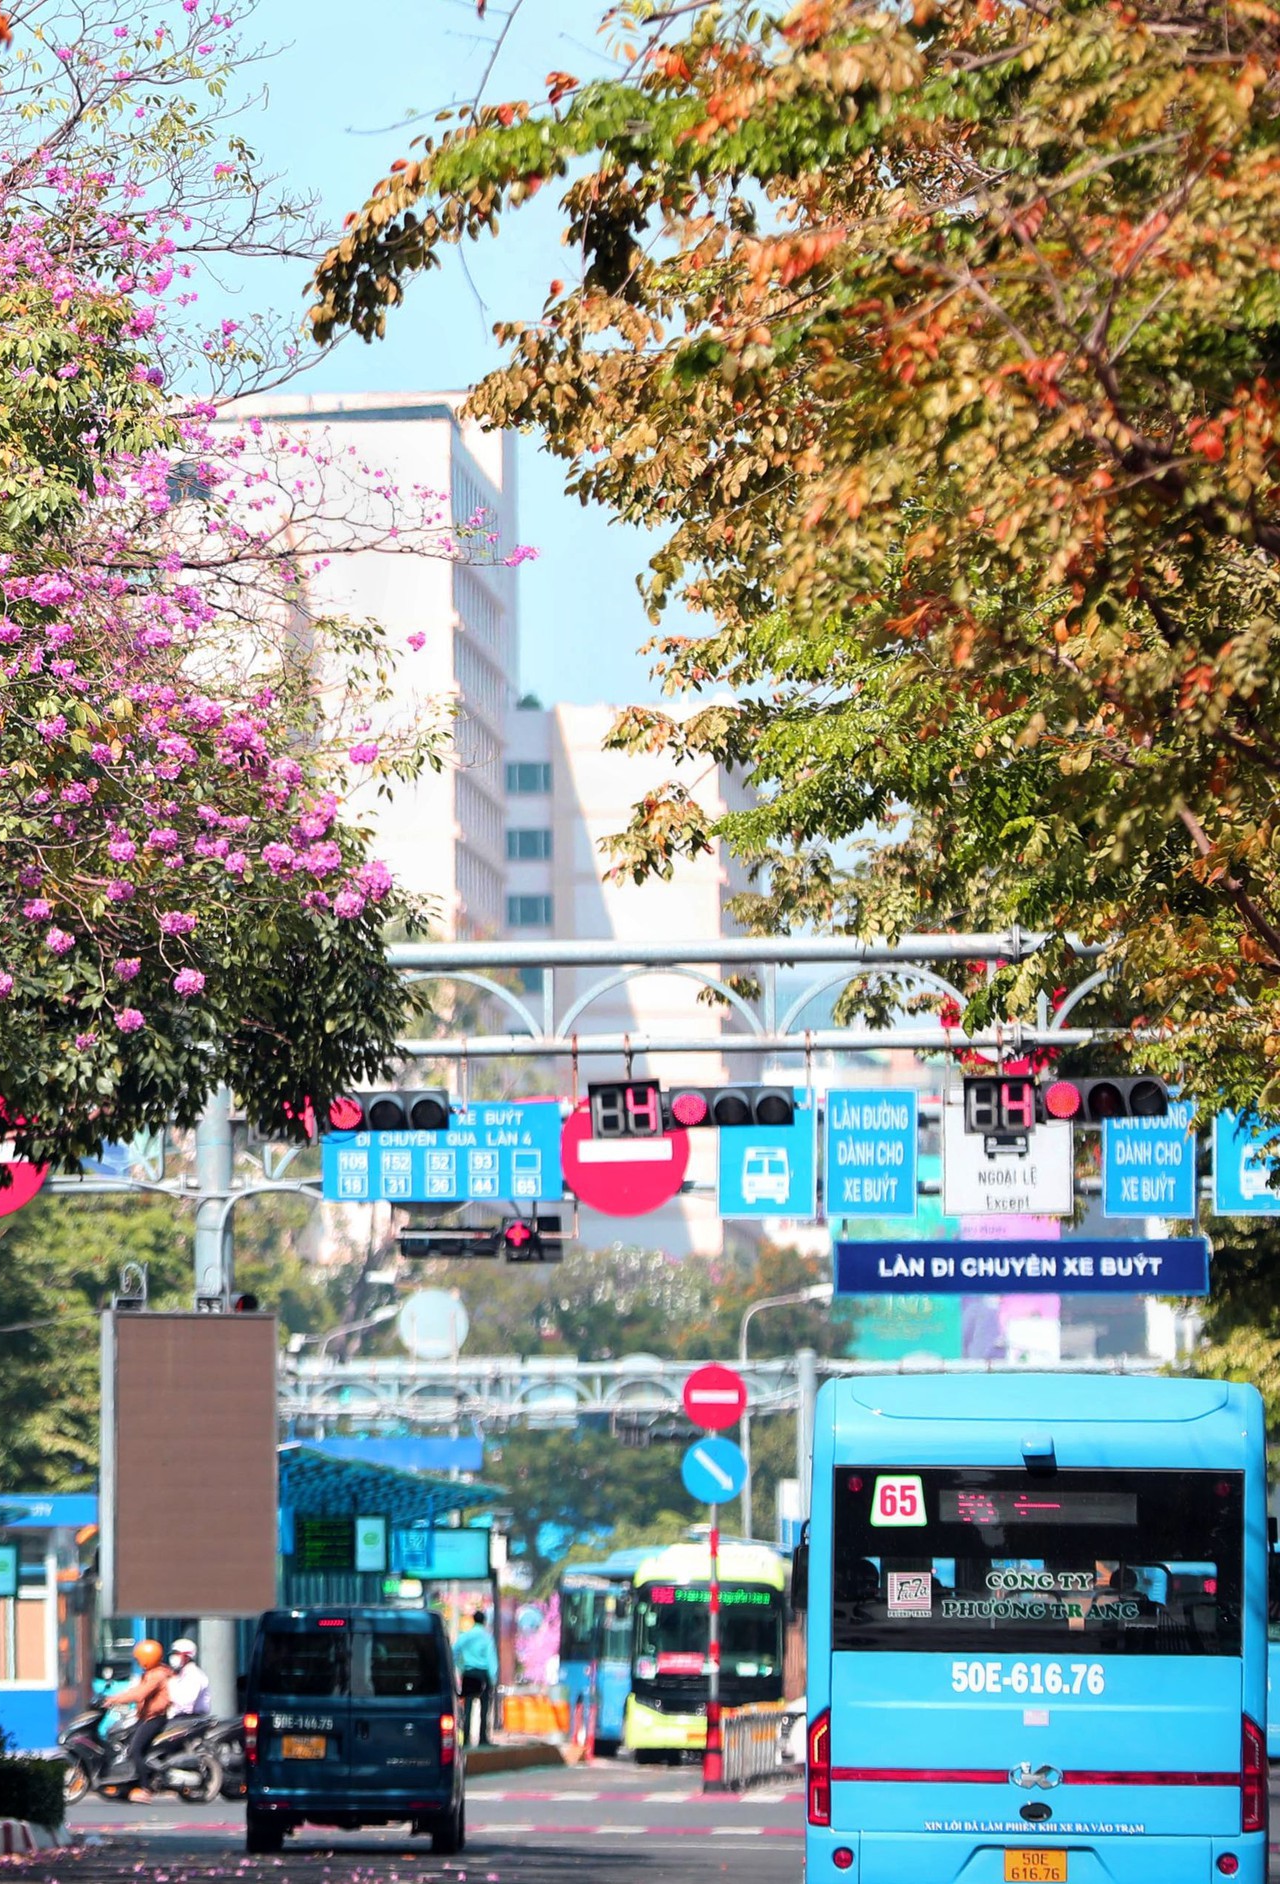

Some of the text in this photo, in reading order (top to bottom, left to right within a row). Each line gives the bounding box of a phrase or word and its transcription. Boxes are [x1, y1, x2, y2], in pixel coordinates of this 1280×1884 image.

[484, 1109, 524, 1126] BUÝT
[832, 1099, 910, 1131] LÀN ĐƯỜNG
[446, 1131, 477, 1147] QUA
[486, 1129, 519, 1147] LÀN
[522, 1132, 533, 1146] 4
[837, 1135, 904, 1166] DÀNH CHO
[1116, 1136, 1182, 1165] DÀNH CHO
[844, 1174, 899, 1202] XE BUÝT
[1122, 1172, 1177, 1202] XE BUÝT
[985, 1194, 1031, 1211] Except
[878, 1253, 925, 1278] LÀN
[1062, 1256, 1095, 1277] XE
[1100, 1252, 1163, 1277] BUÝT
[879, 1484, 918, 1517] 65
[985, 1567, 1095, 1591] CÔNG TY
[941, 1599, 1140, 1620] PHƯƠNG TRANG
[951, 1660, 1106, 1696] 50E-616.76
[924, 1821, 943, 1831] XIN
[1038, 1822, 1058, 1832] KHI
[1059, 1822, 1074, 1832] XE
[1075, 1823, 1090, 1833] RA
[1115, 1823, 1145, 1835] TRẠM
[1022, 1853, 1049, 1866] 50E
[1011, 1867, 1060, 1881] 616.76
